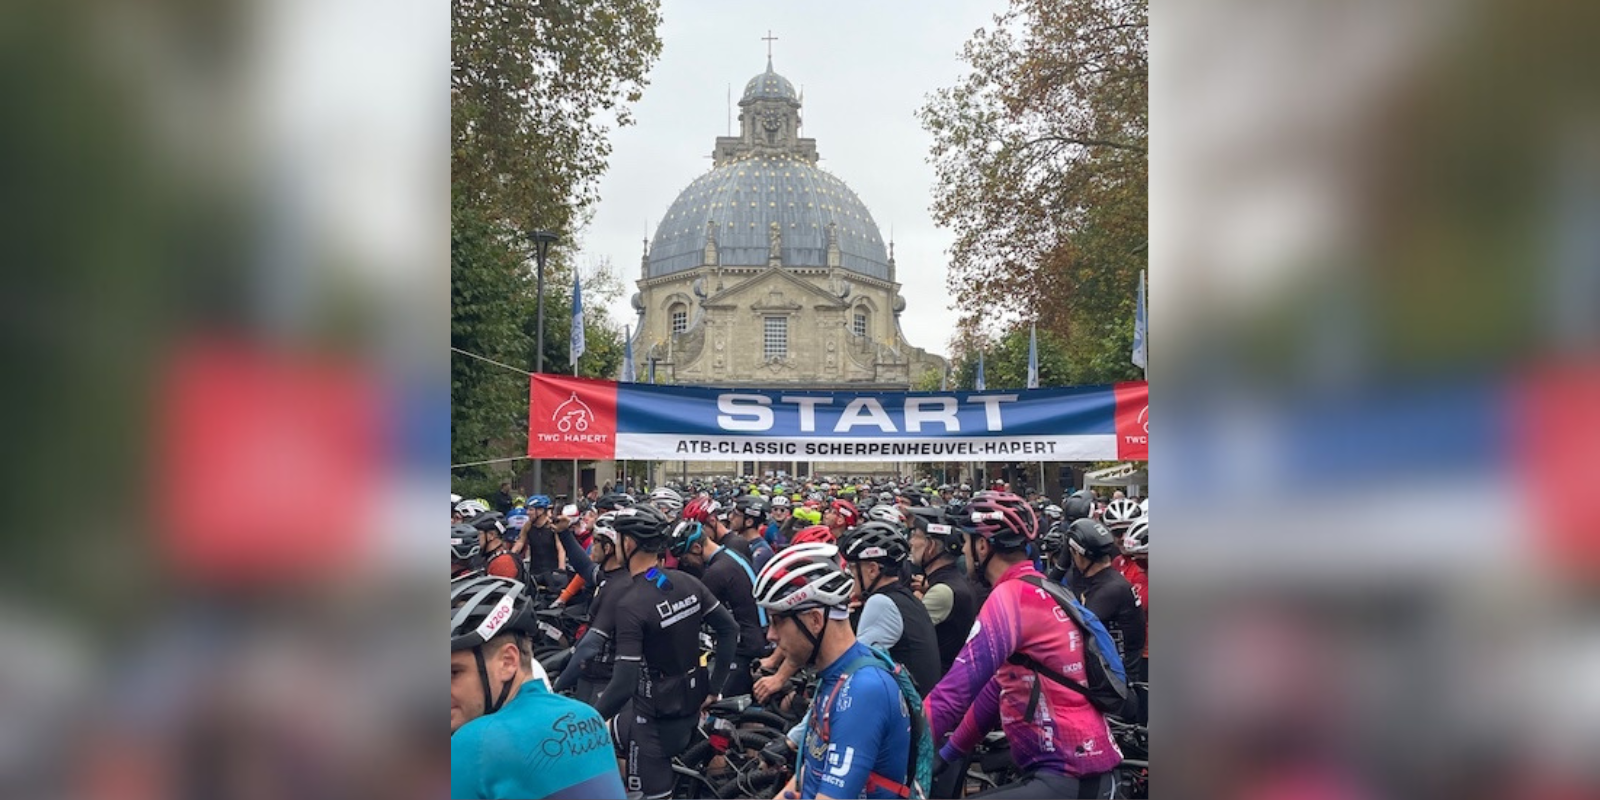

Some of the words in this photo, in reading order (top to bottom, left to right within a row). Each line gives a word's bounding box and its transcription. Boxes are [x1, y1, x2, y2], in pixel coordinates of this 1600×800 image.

[716, 393, 1020, 433] START
[538, 433, 560, 442] TWC
[564, 433, 608, 443] HAPERT
[1125, 435, 1147, 444] TWC
[676, 440, 797, 455] ATB-CLASSIC
[805, 441, 1057, 457] SCHERPENHEUVEL-HAPERT
[486, 604, 510, 631] V200
